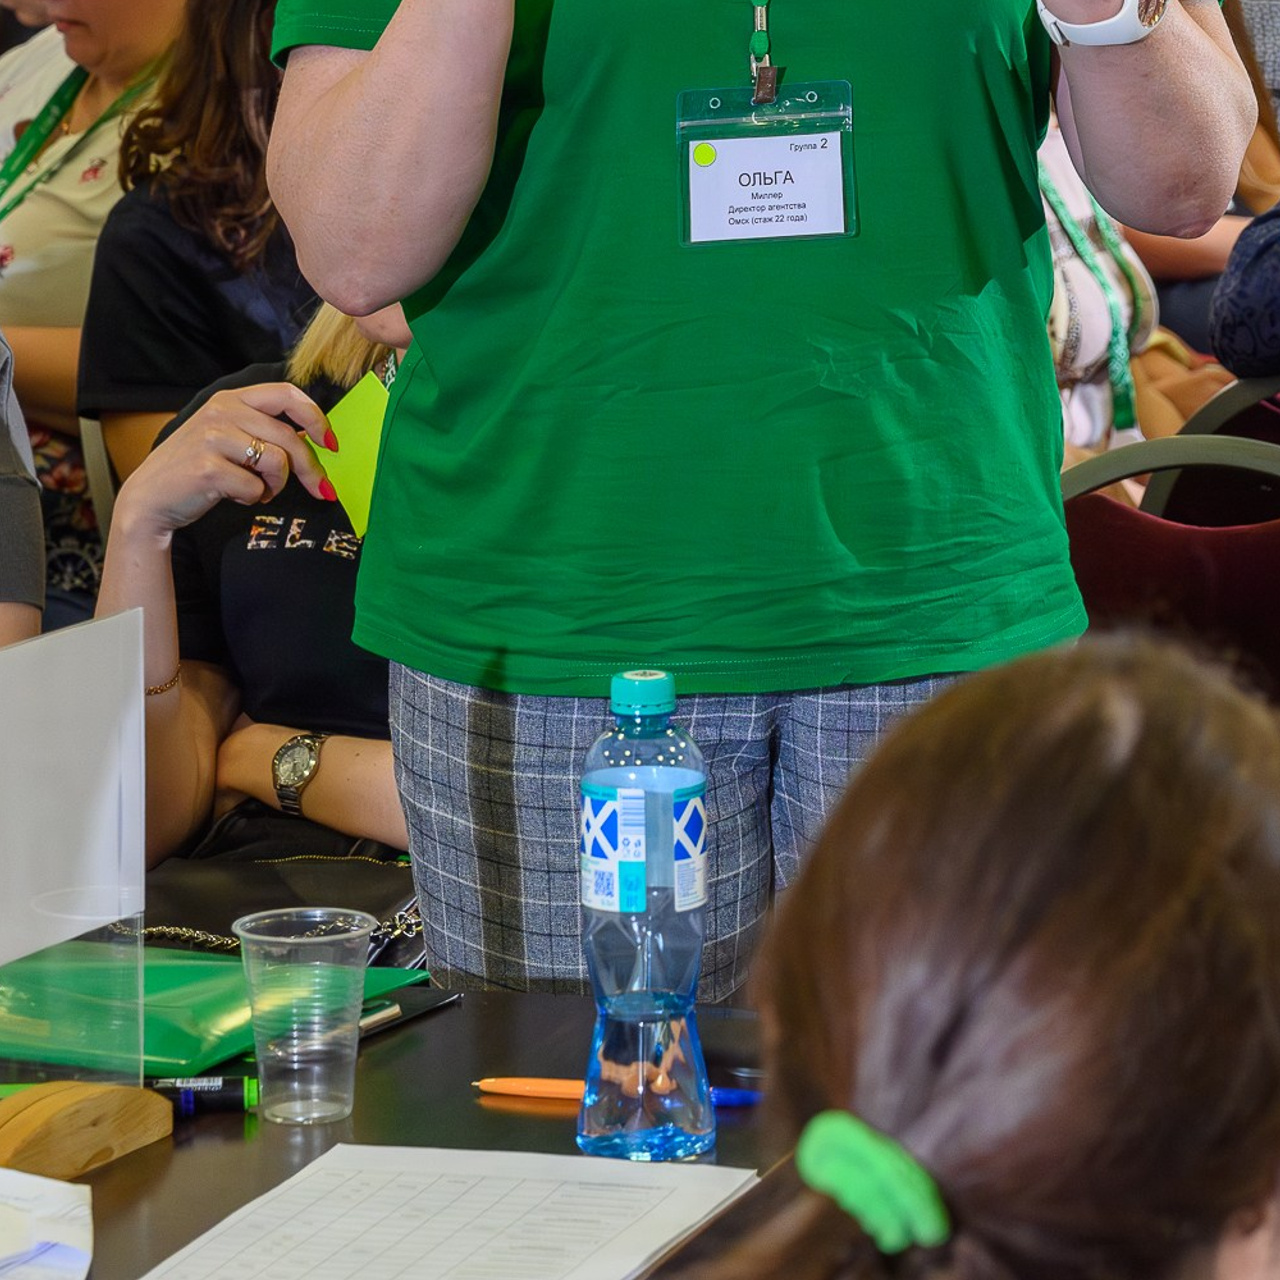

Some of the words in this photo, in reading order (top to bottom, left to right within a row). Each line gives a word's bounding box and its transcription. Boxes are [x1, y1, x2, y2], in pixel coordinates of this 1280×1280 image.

[789, 143, 817, 152] Группа
[820, 138, 828, 149] 2
[738, 171, 795, 187] ОЛЬГА
[751, 192, 783, 201] Миллер
[728, 205, 766, 214] Директор
[768, 202, 806, 211] агентства
[728, 217, 749, 226] Омск
[751, 216, 773, 226] (стаж
[775, 214, 785, 223] 22
[786, 213, 808, 222] года)
